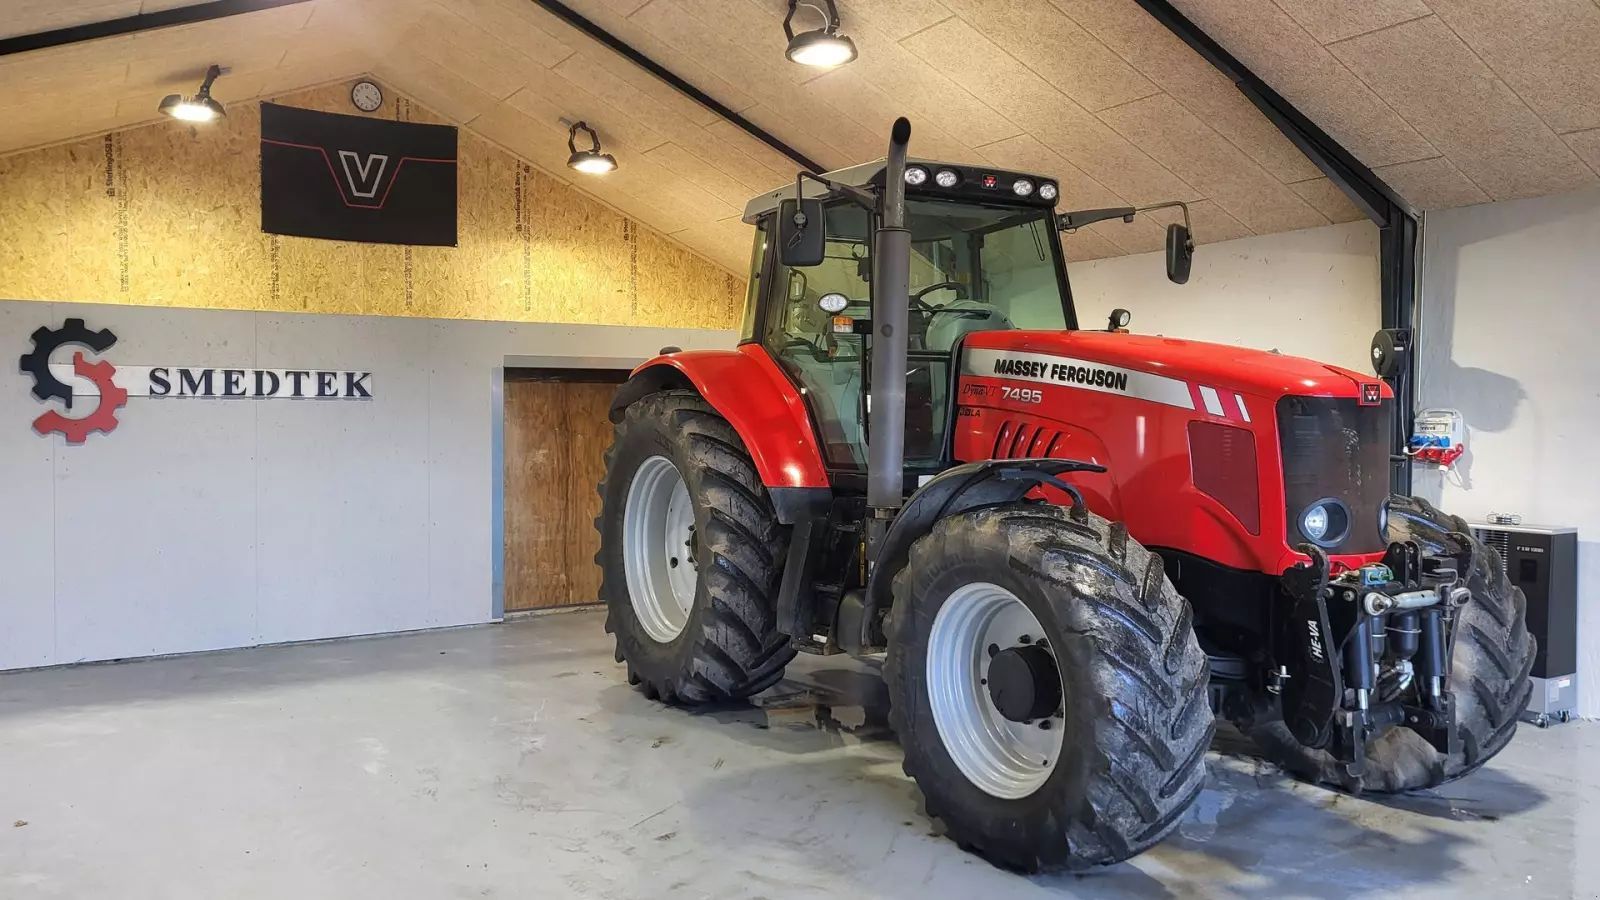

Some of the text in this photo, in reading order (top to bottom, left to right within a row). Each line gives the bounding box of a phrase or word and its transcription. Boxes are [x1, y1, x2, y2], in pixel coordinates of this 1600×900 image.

[338, 150, 388, 198] V
[149, 367, 373, 397] SMEDTEK
[994, 358, 1127, 391] MASSEY FERGUSON
[1001, 386, 1042, 404] 7495
[1307, 620, 1324, 659] HE-VA
